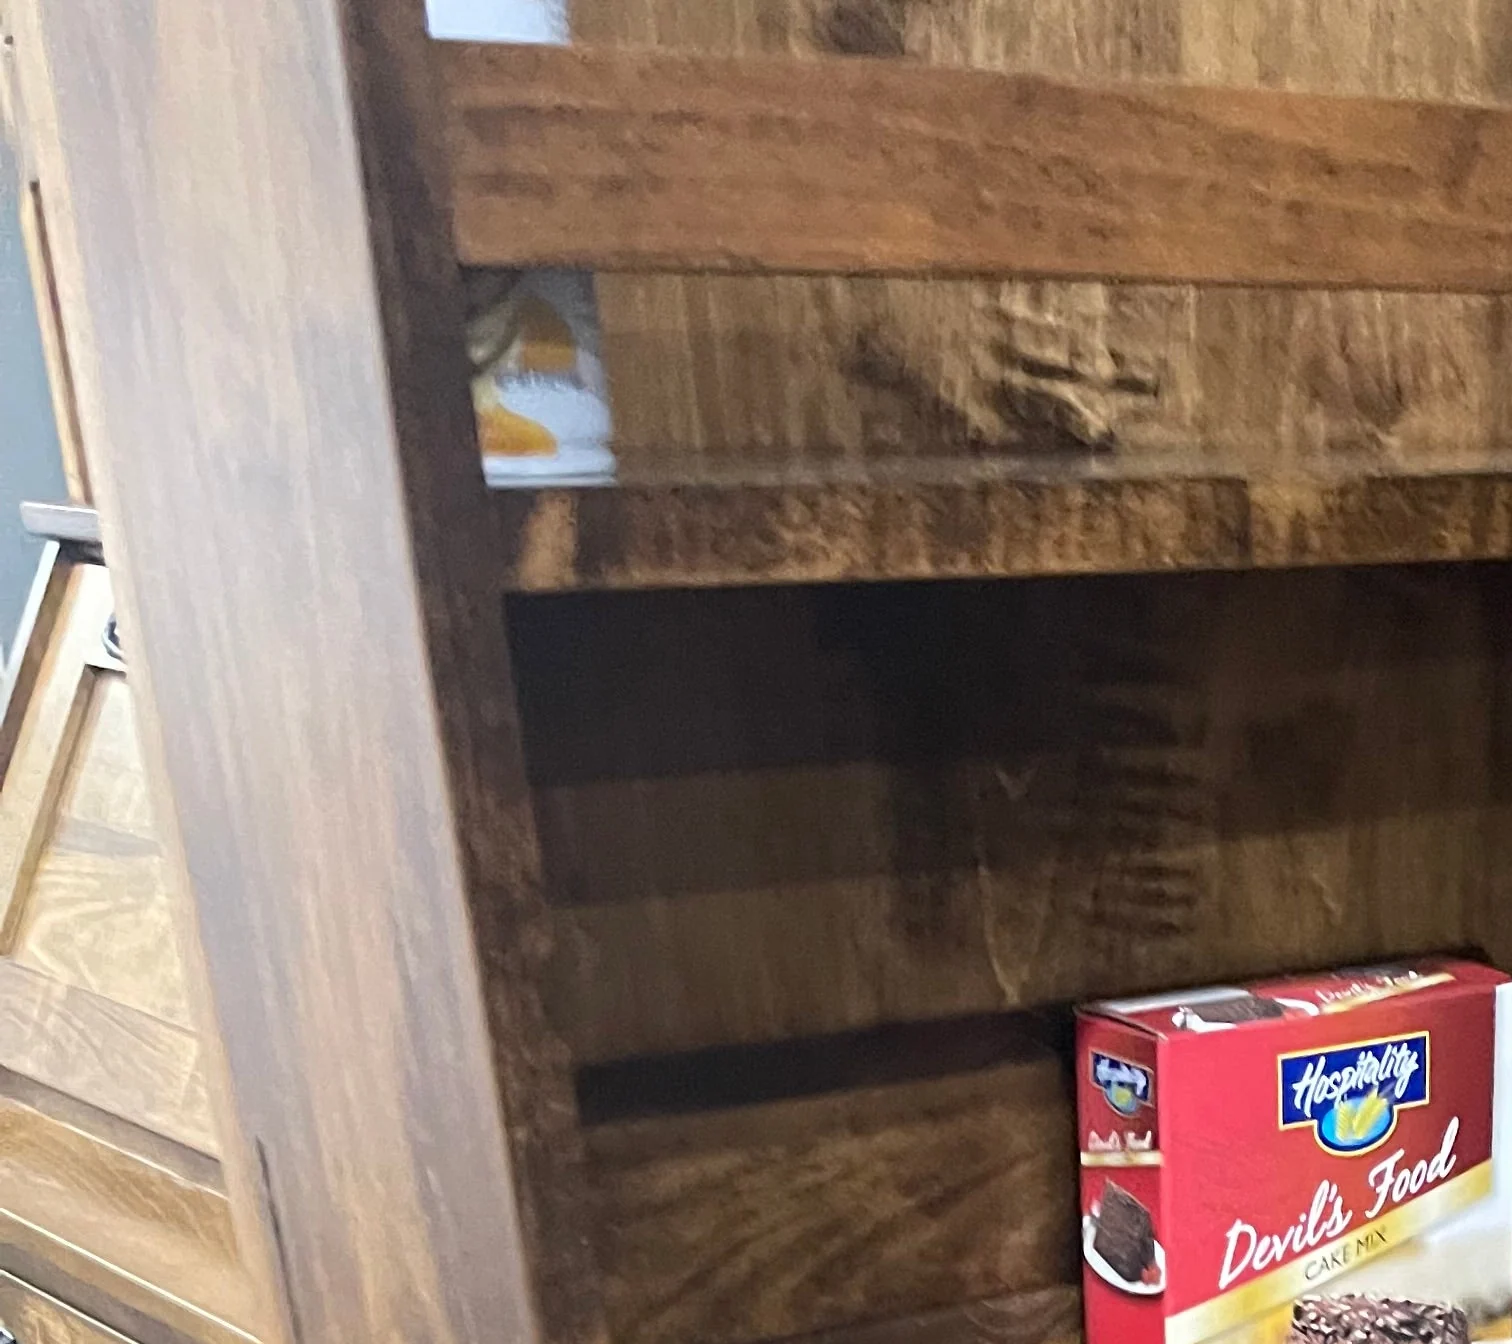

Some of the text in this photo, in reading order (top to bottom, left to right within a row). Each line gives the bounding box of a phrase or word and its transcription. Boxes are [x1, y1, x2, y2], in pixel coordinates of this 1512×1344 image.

[1292, 1042, 1419, 1118] Hospitality
[1218, 1115, 1460, 1290] Devil's Food
[1304, 1224, 1388, 1281] CAKE MIX
